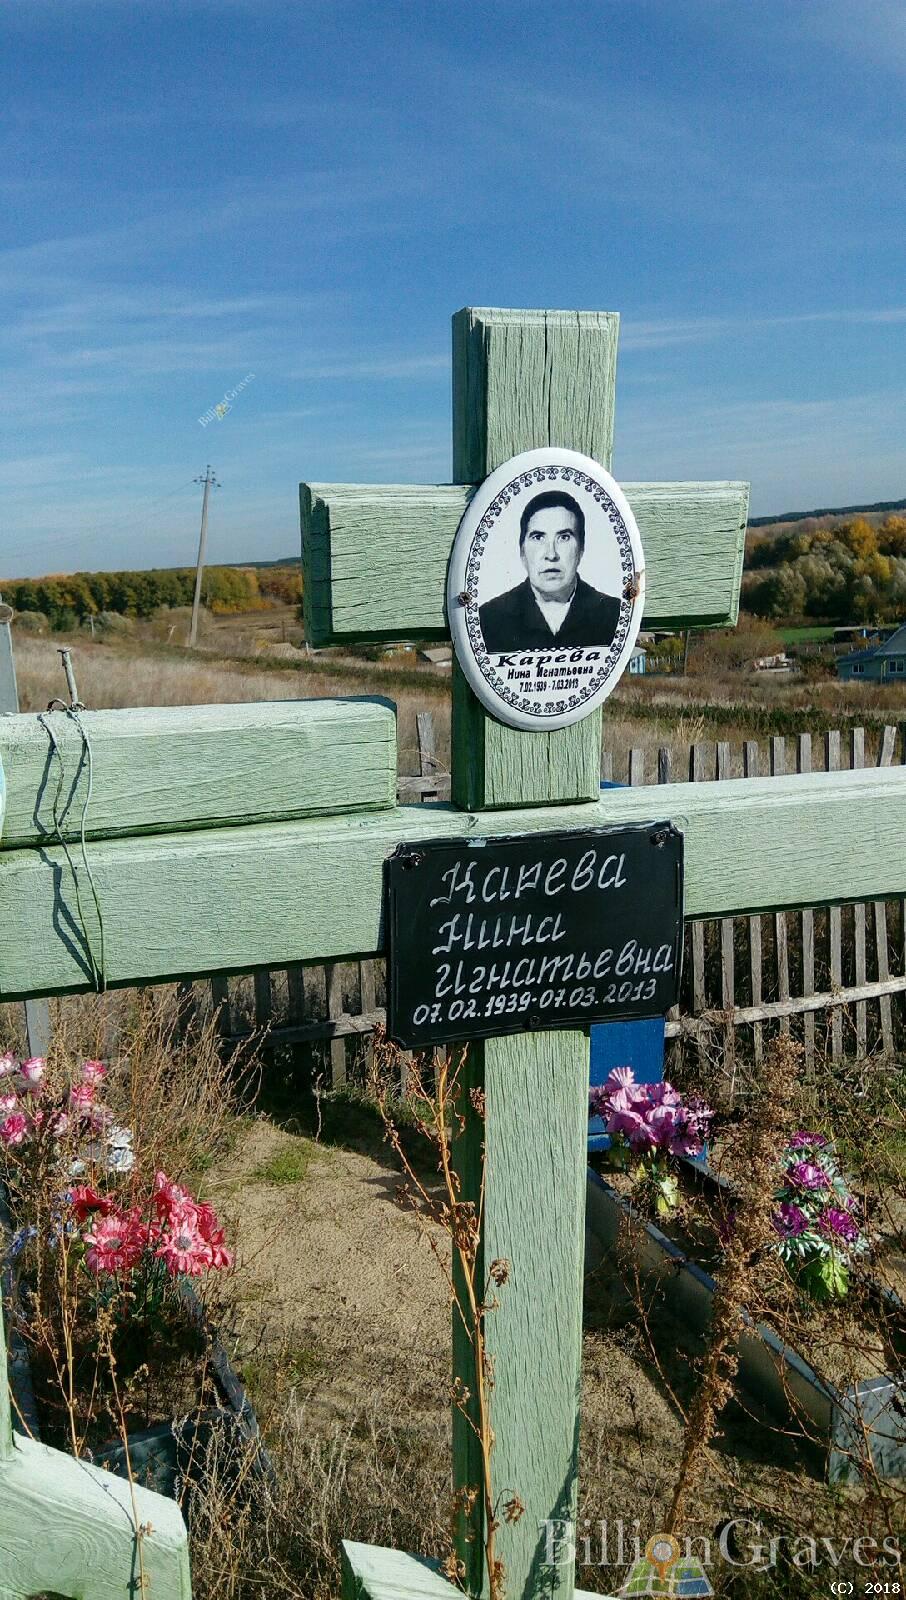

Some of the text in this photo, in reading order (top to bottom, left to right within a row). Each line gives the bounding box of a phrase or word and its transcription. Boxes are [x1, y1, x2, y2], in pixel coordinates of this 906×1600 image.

[495, 650, 600, 667] Карева
[507, 665, 594, 680] Нина Игнатьевна
[430, 850, 627, 907] Карева
[432, 913, 567, 955] Нина
[435, 939, 674, 998] Игнатьевна
